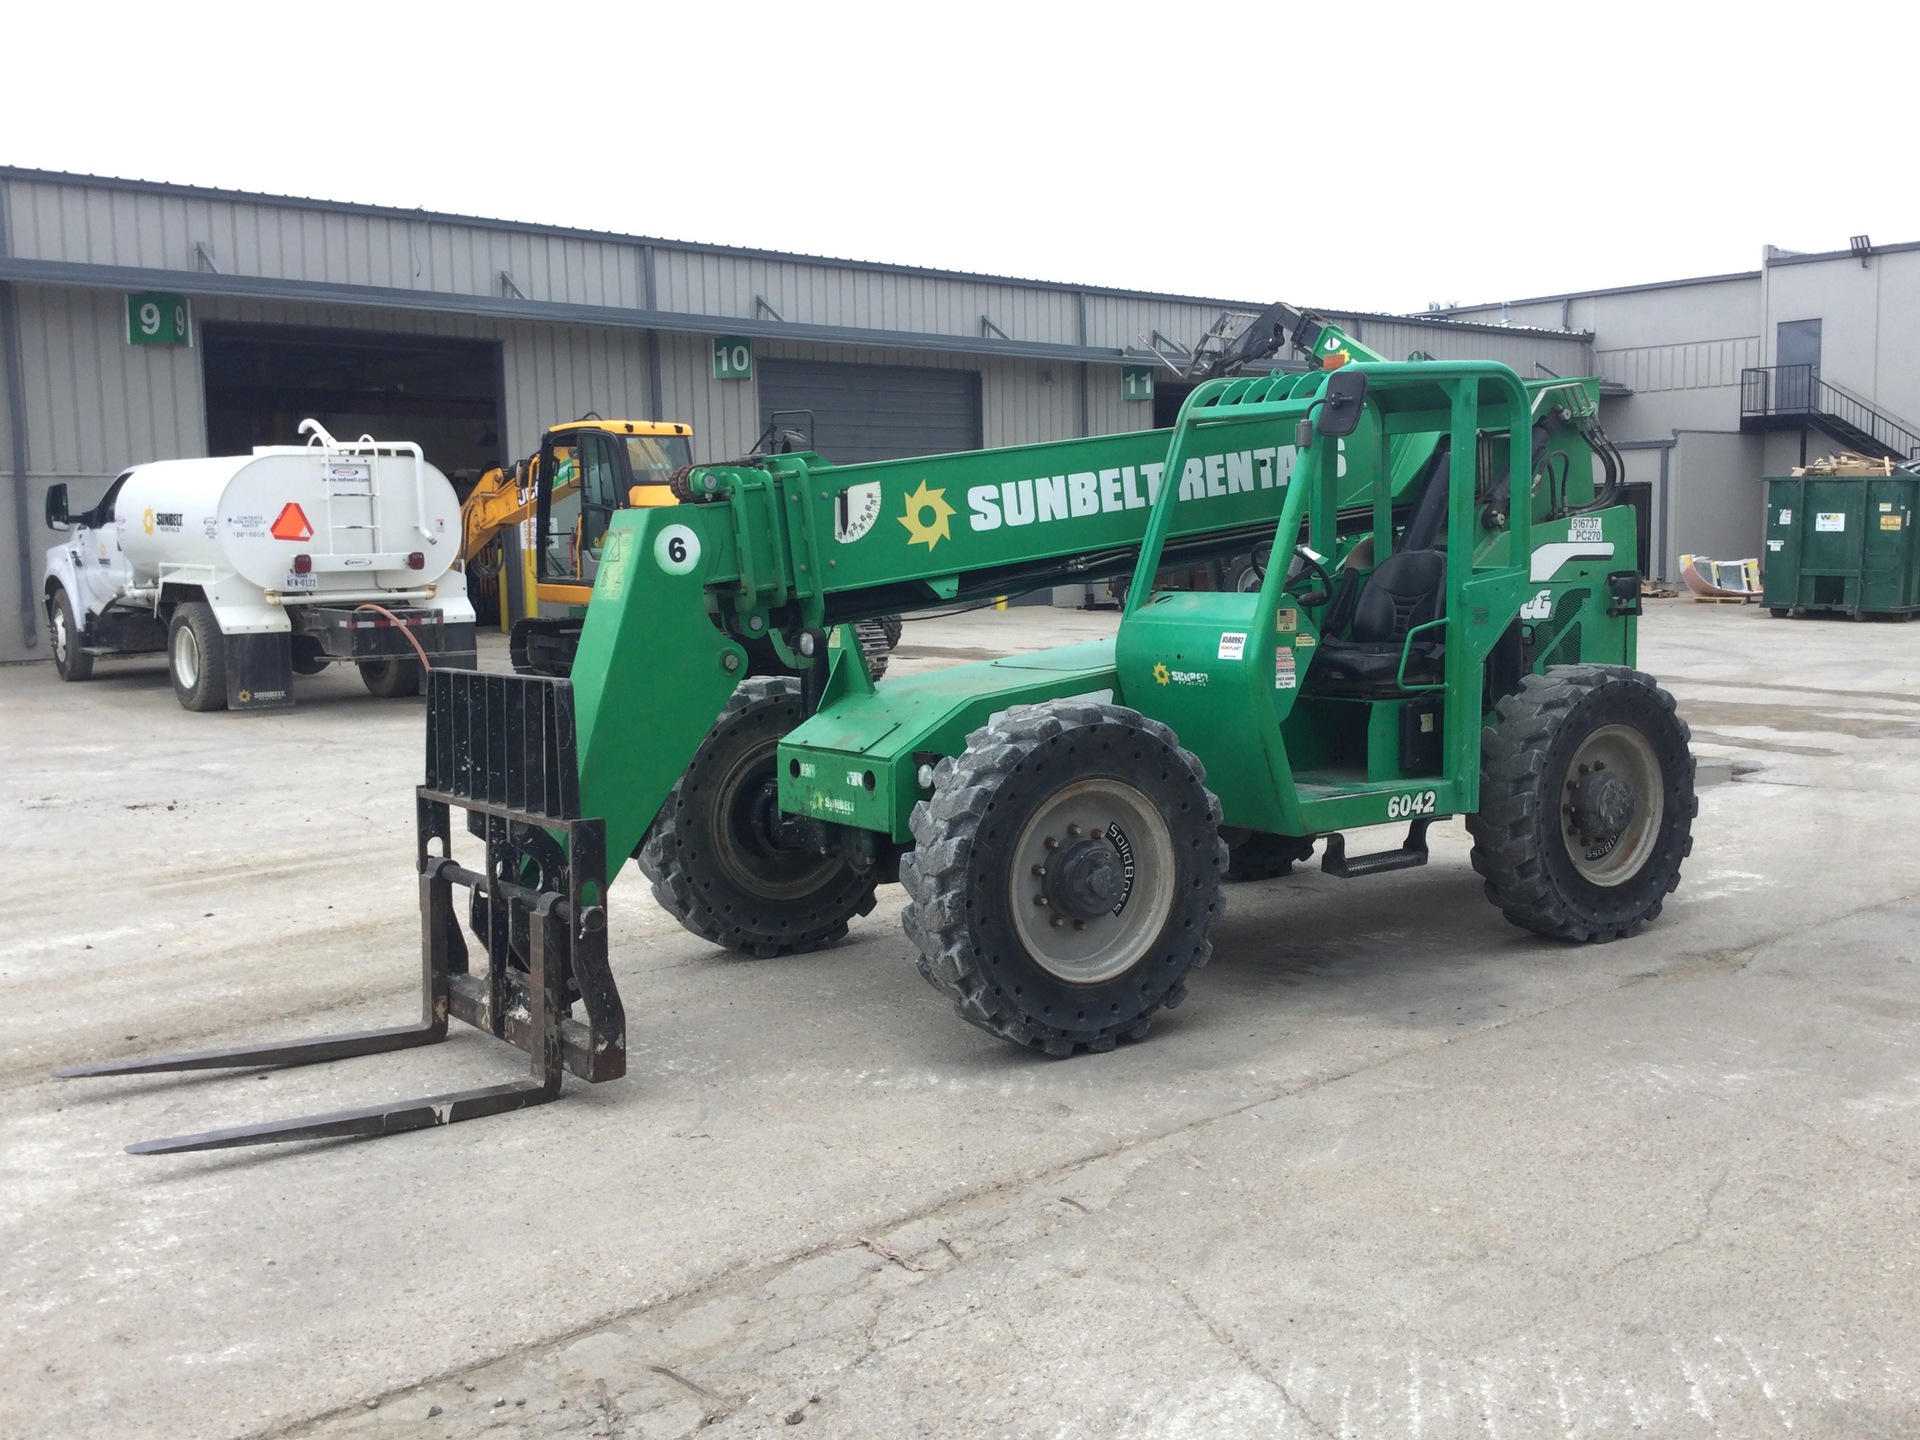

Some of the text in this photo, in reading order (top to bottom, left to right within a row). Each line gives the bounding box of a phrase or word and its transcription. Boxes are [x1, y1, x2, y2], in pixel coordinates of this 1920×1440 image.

[140, 303, 160, 335] 9
[175, 305, 185, 337] 9
[716, 345, 749, 371] 10
[1125, 372, 1151, 394] 11
[966, 438, 1347, 532] SUNBELT RENTA
[156, 513, 183, 527] SUNBELT
[1572, 518, 1599, 529] 516737
[1575, 530, 1601, 541] PC270
[668, 537, 687, 563] 6
[1519, 589, 1553, 620] LG
[1387, 790, 1436, 818] 6042
